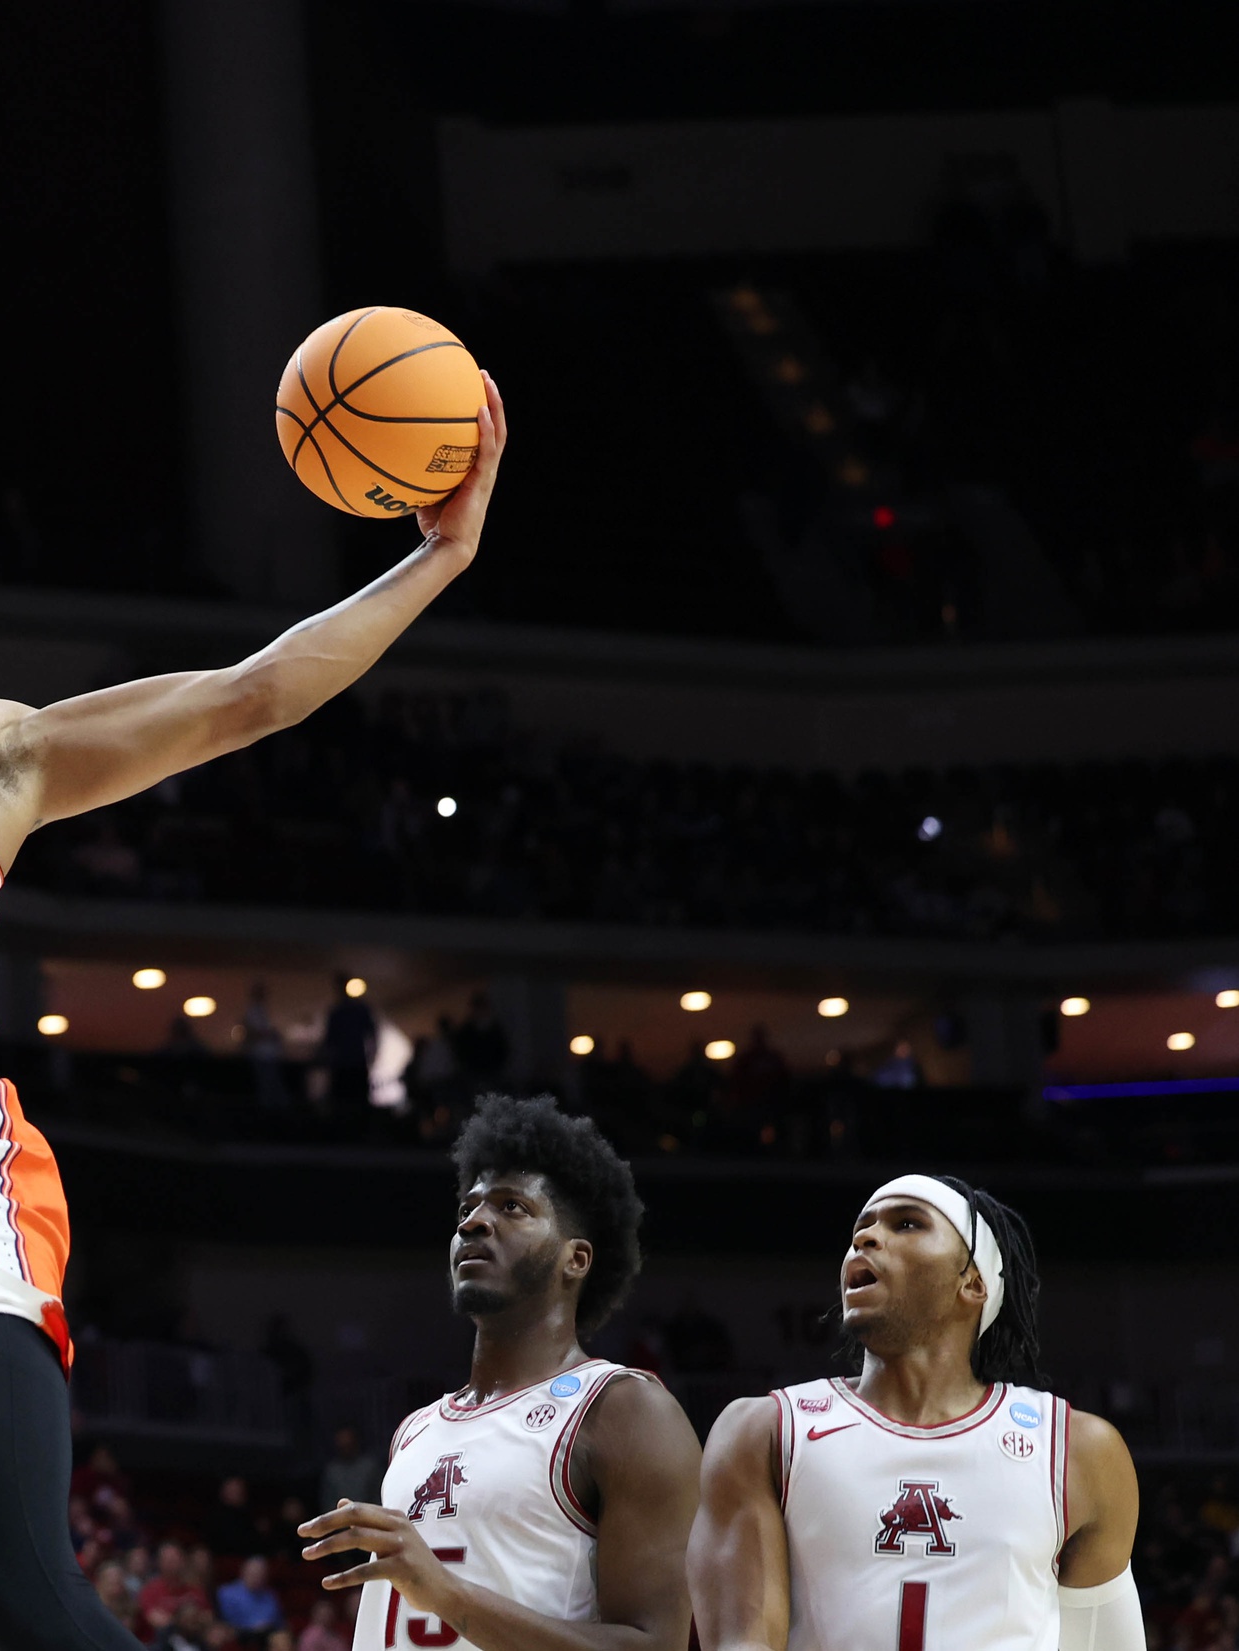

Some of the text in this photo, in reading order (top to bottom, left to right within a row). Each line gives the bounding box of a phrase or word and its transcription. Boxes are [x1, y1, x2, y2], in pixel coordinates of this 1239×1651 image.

[526, 1403, 556, 1428] SEC
[1013, 1410, 1040, 1426] NCAA
[1003, 1431, 1033, 1458] SEC
[875, 1479, 956, 1556] A
